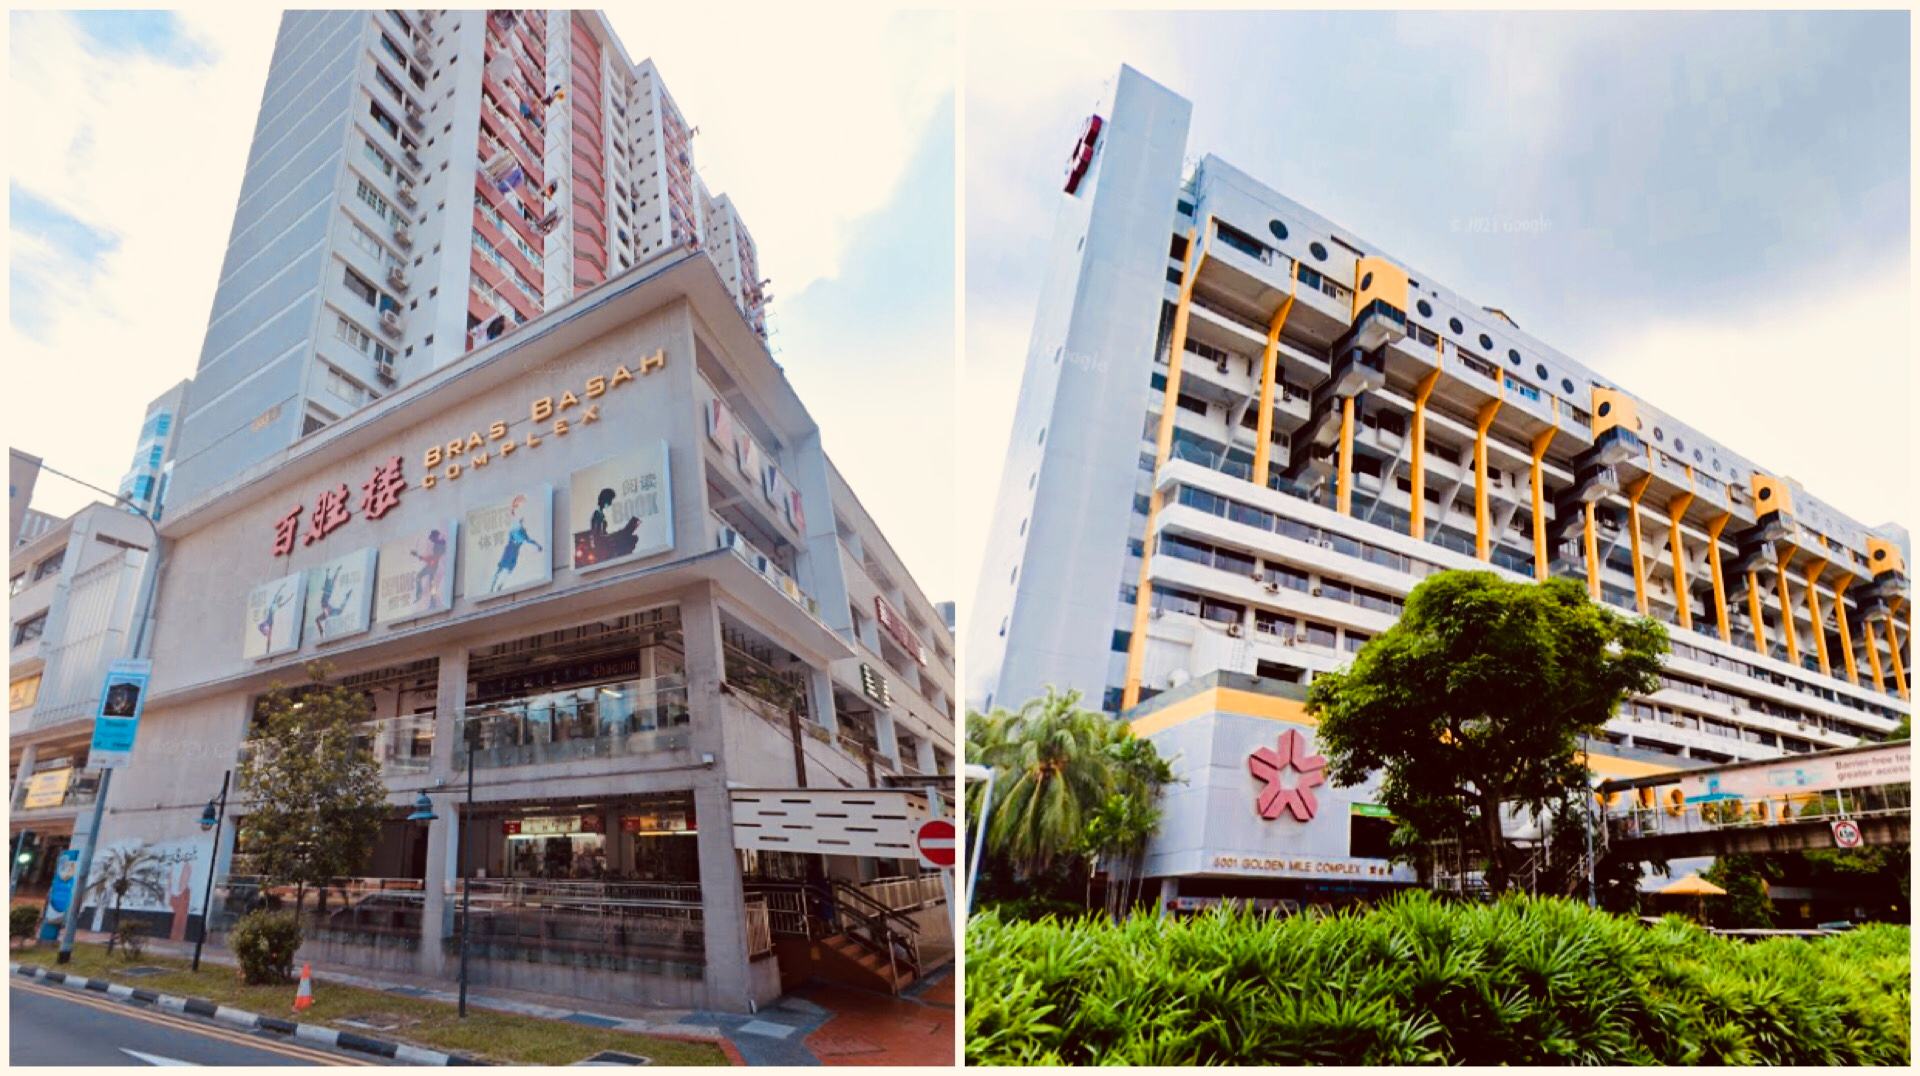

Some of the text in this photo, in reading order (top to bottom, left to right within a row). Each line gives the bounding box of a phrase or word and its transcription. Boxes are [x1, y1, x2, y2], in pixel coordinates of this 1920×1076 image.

[422, 347, 669, 469] BRAS BASAH
[420, 404, 603, 489] COMPLEX
[271, 454, 408, 558] 百胜楼
[611, 492, 660, 524] BOOK
[1835, 757, 1892, 770] Barrier-free
[1838, 769, 1873, 782] greater
[1241, 858, 1284, 871] GOLDEN
[1288, 860, 1312, 873] MILE
[1315, 861, 1361, 875] COMPLEX
